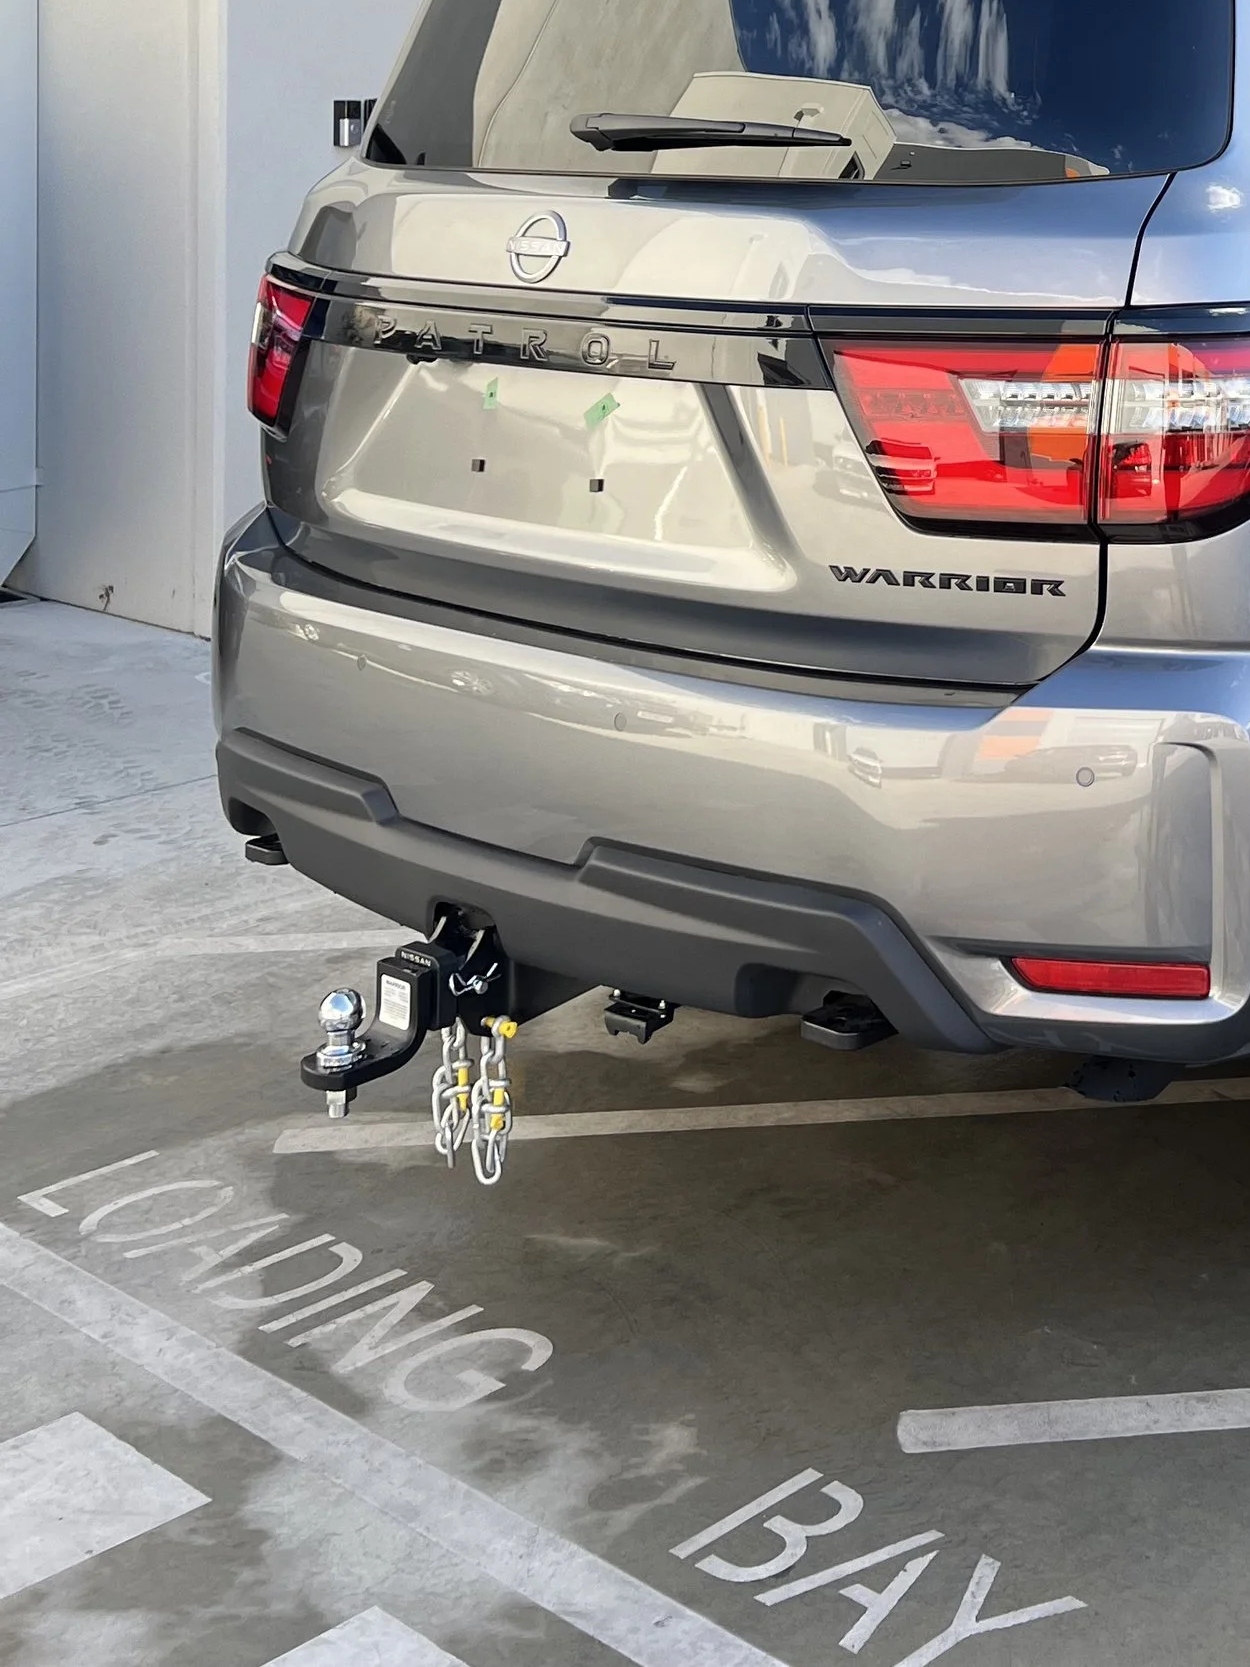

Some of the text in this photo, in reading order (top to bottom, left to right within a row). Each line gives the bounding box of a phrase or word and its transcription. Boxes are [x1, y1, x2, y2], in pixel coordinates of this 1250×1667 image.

[508, 237, 567, 255] NISSAN
[374, 315, 677, 371] PATROL
[830, 564, 1067, 597] WARRIOR
[401, 951, 431, 967] NISSAN
[17, 1150, 555, 1412] LOADING
[668, 1467, 1088, 1667] BAY
